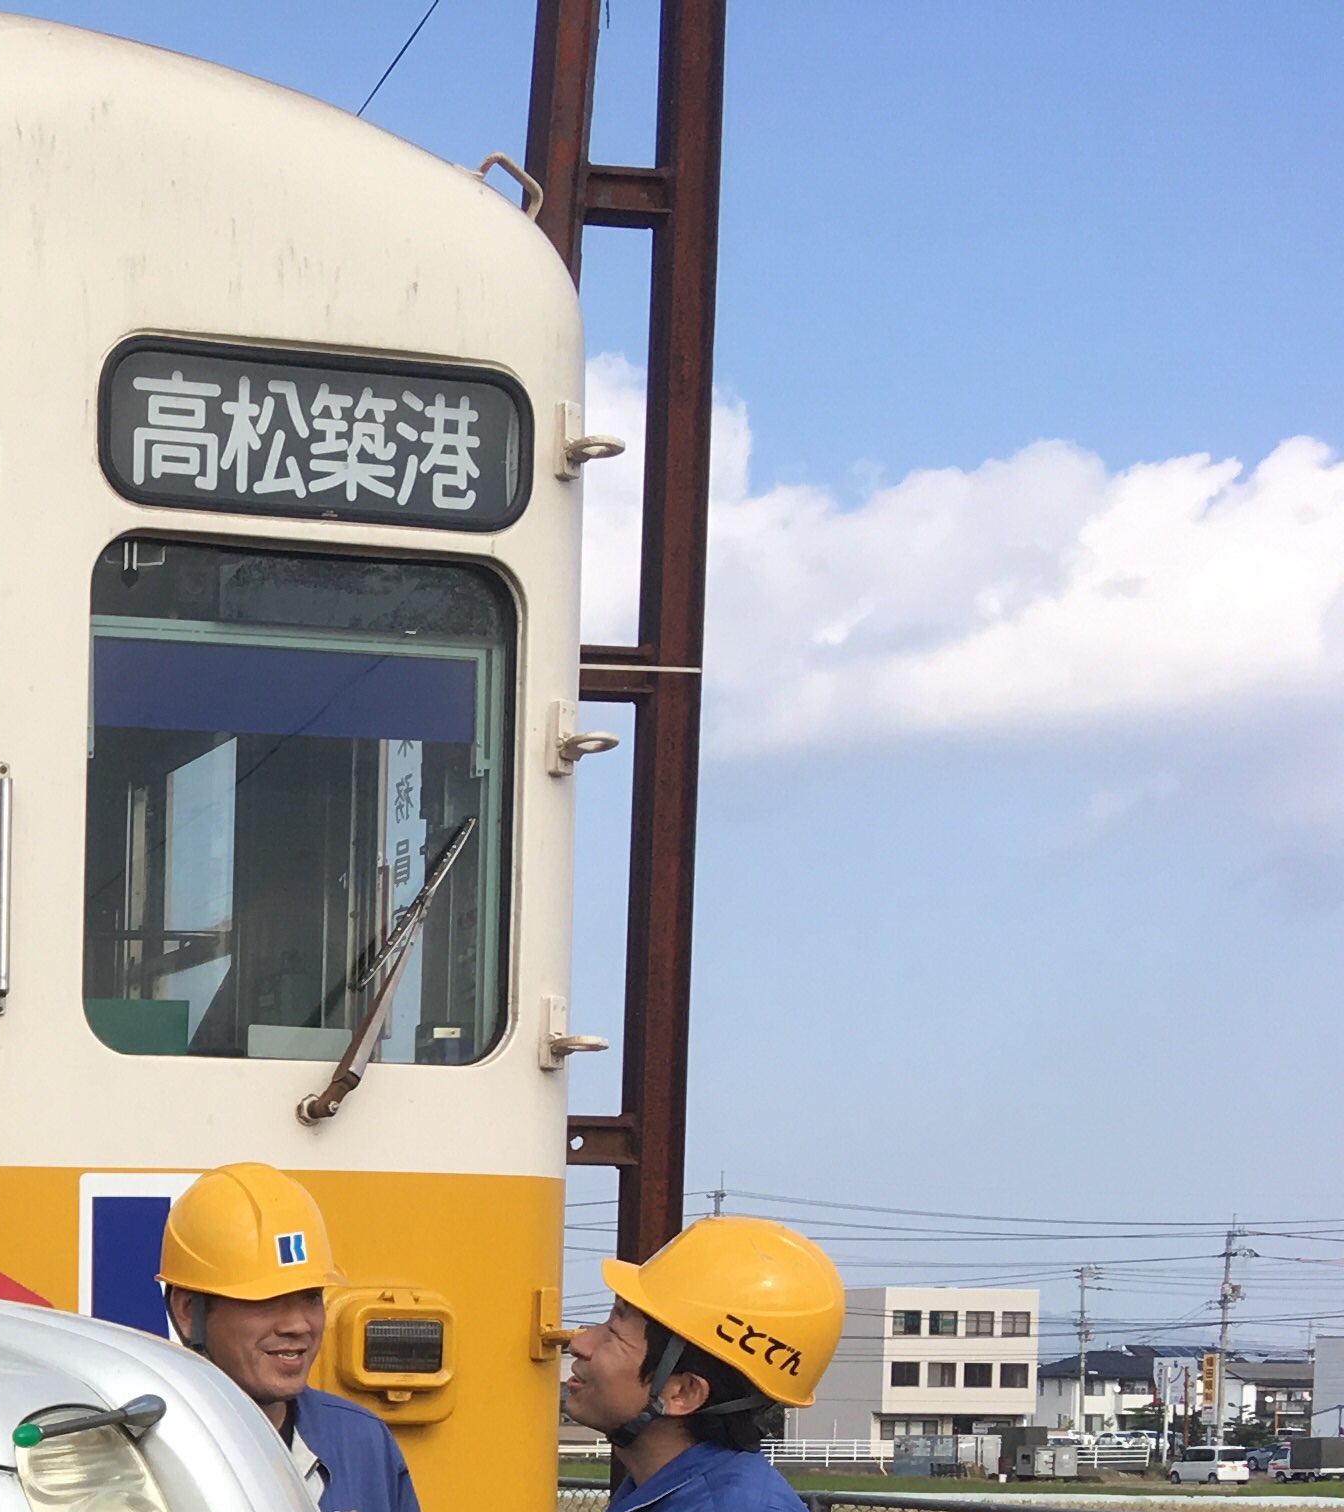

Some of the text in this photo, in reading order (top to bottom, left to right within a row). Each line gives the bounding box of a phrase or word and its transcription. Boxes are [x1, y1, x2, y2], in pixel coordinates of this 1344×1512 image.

[132, 370, 480, 511] 高松築港
[715, 1313, 803, 1377] ことでん
